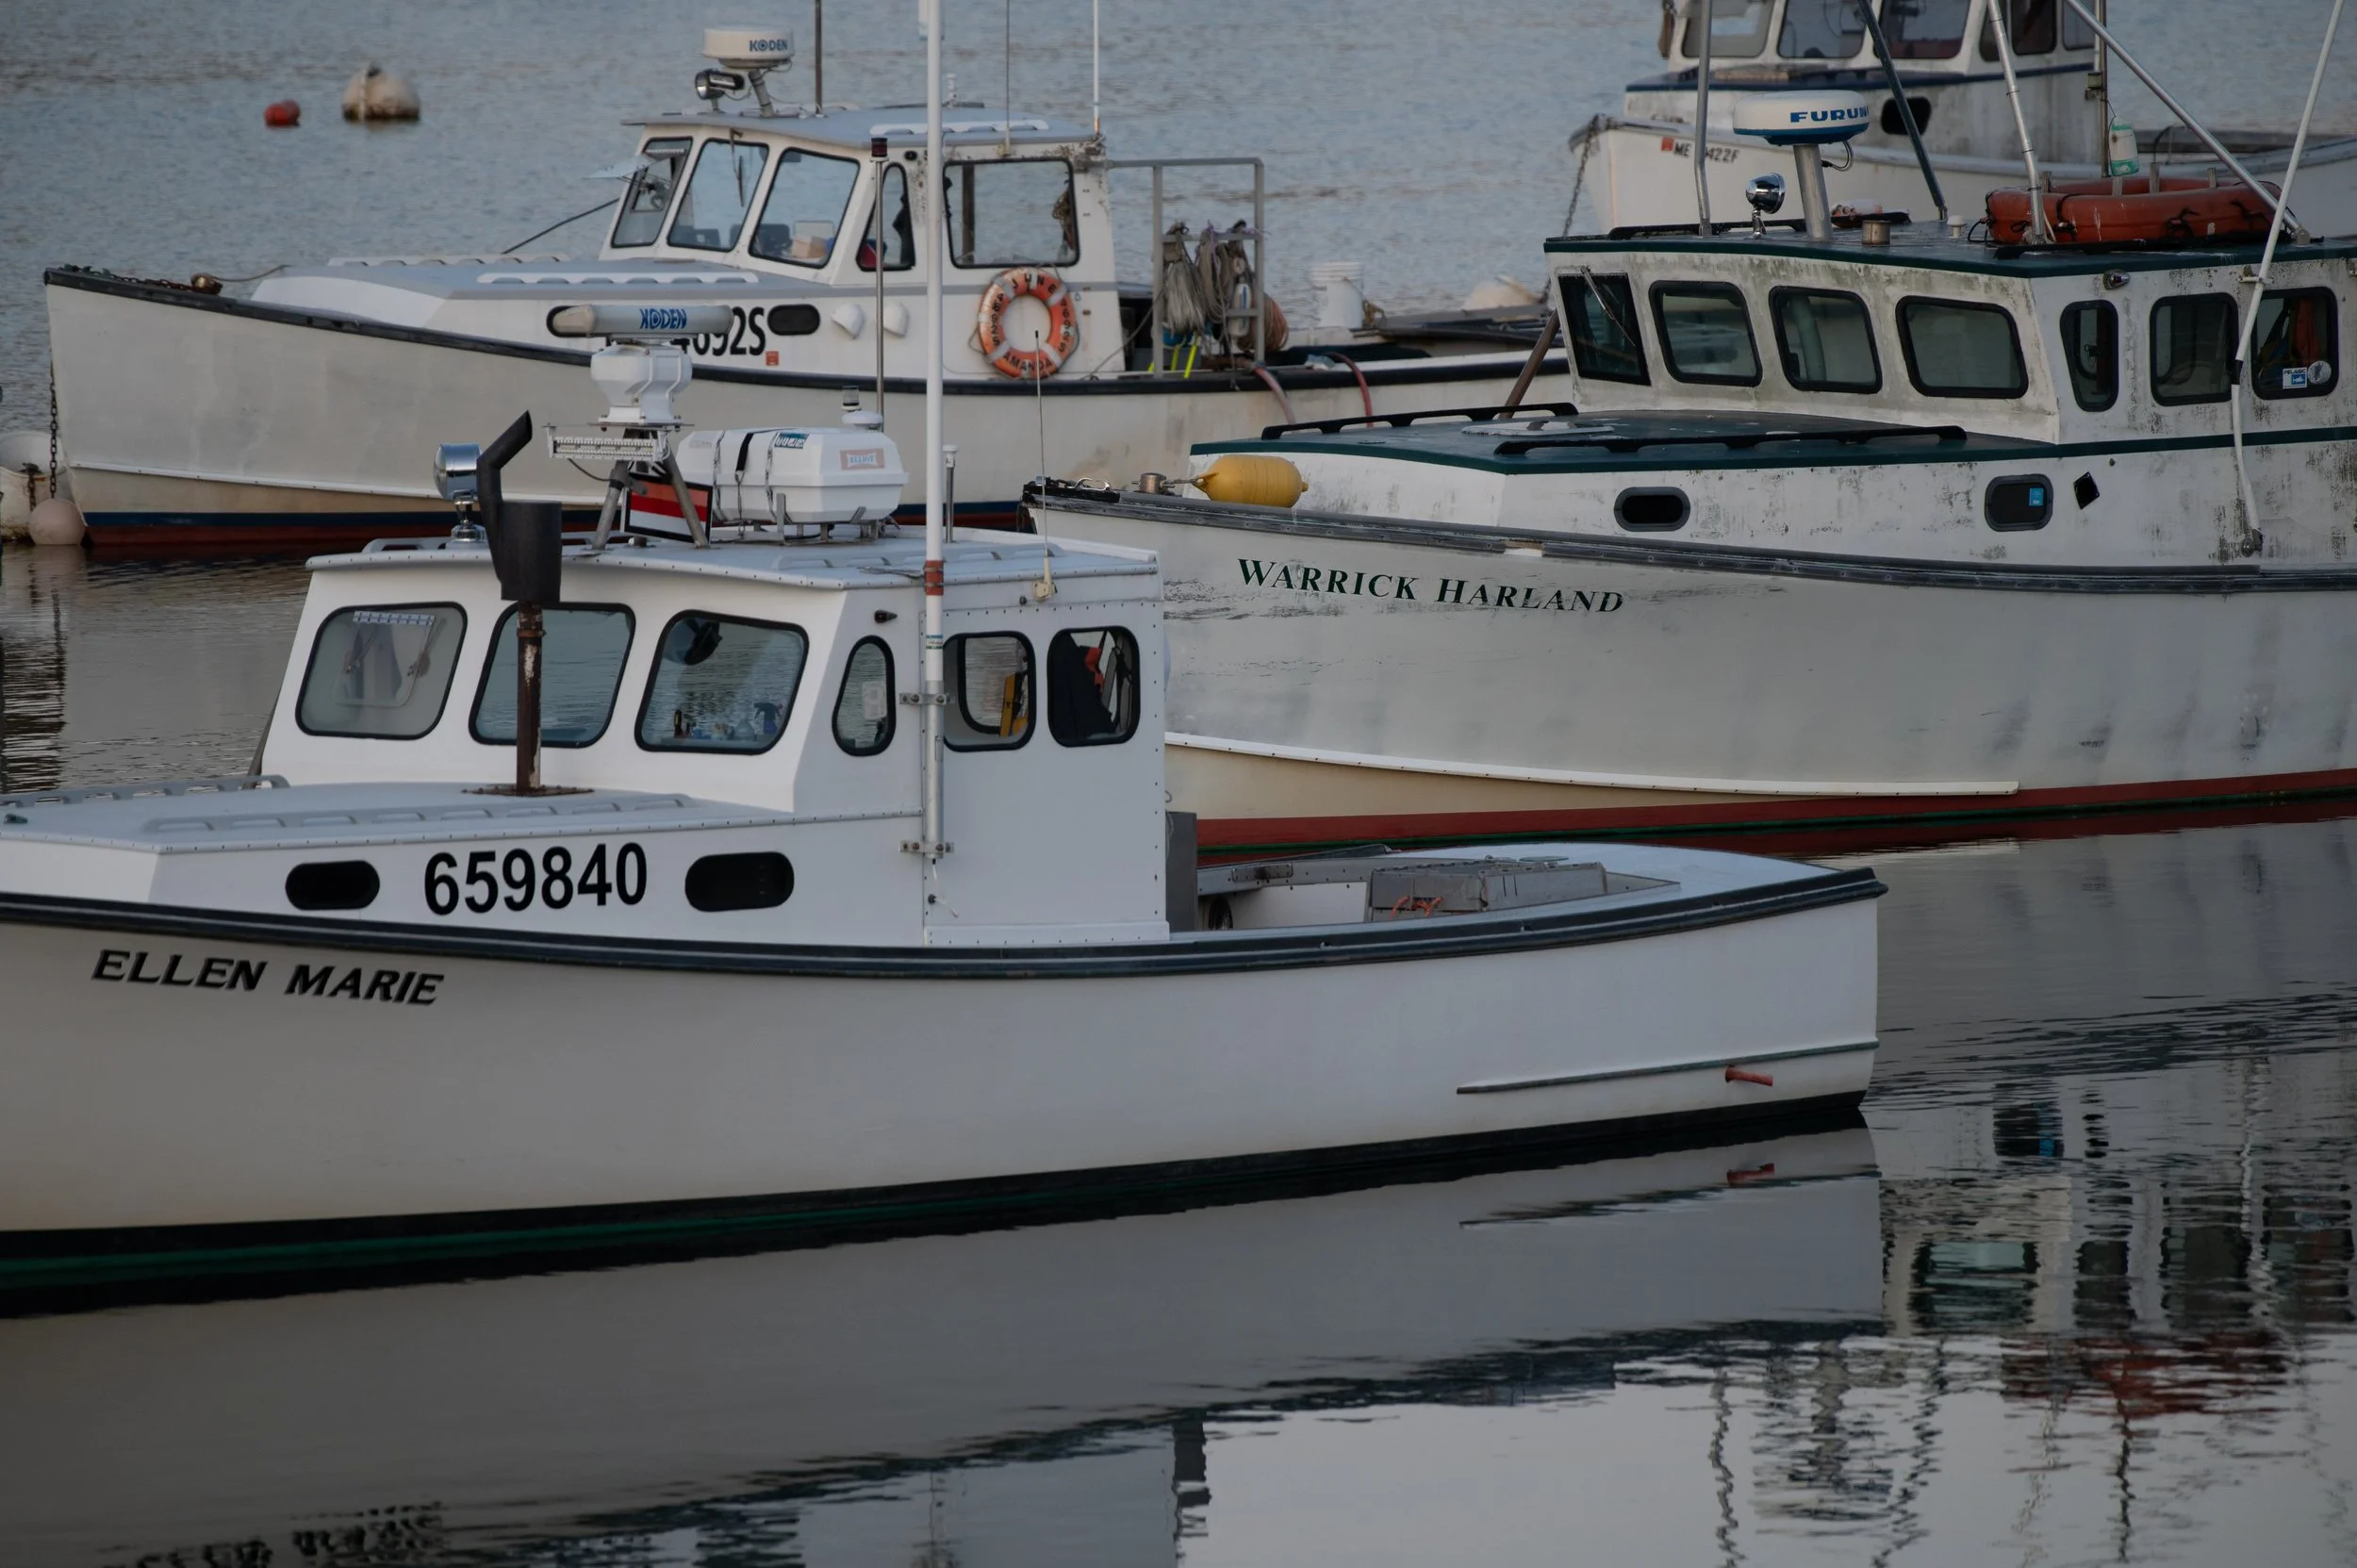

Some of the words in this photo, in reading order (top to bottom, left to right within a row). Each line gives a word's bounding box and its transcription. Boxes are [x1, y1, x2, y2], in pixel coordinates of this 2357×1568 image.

[750, 40, 788, 52] KODEN
[1011, 272, 1058, 294] JUNE
[639, 308, 687, 329] KODEN
[1237, 558, 1419, 601] WARRICK
[1436, 577, 1624, 613] HARLAND
[424, 842, 647, 916] 659840
[91, 949, 269, 991] ELLEN
[284, 965, 445, 1006] MARIE
